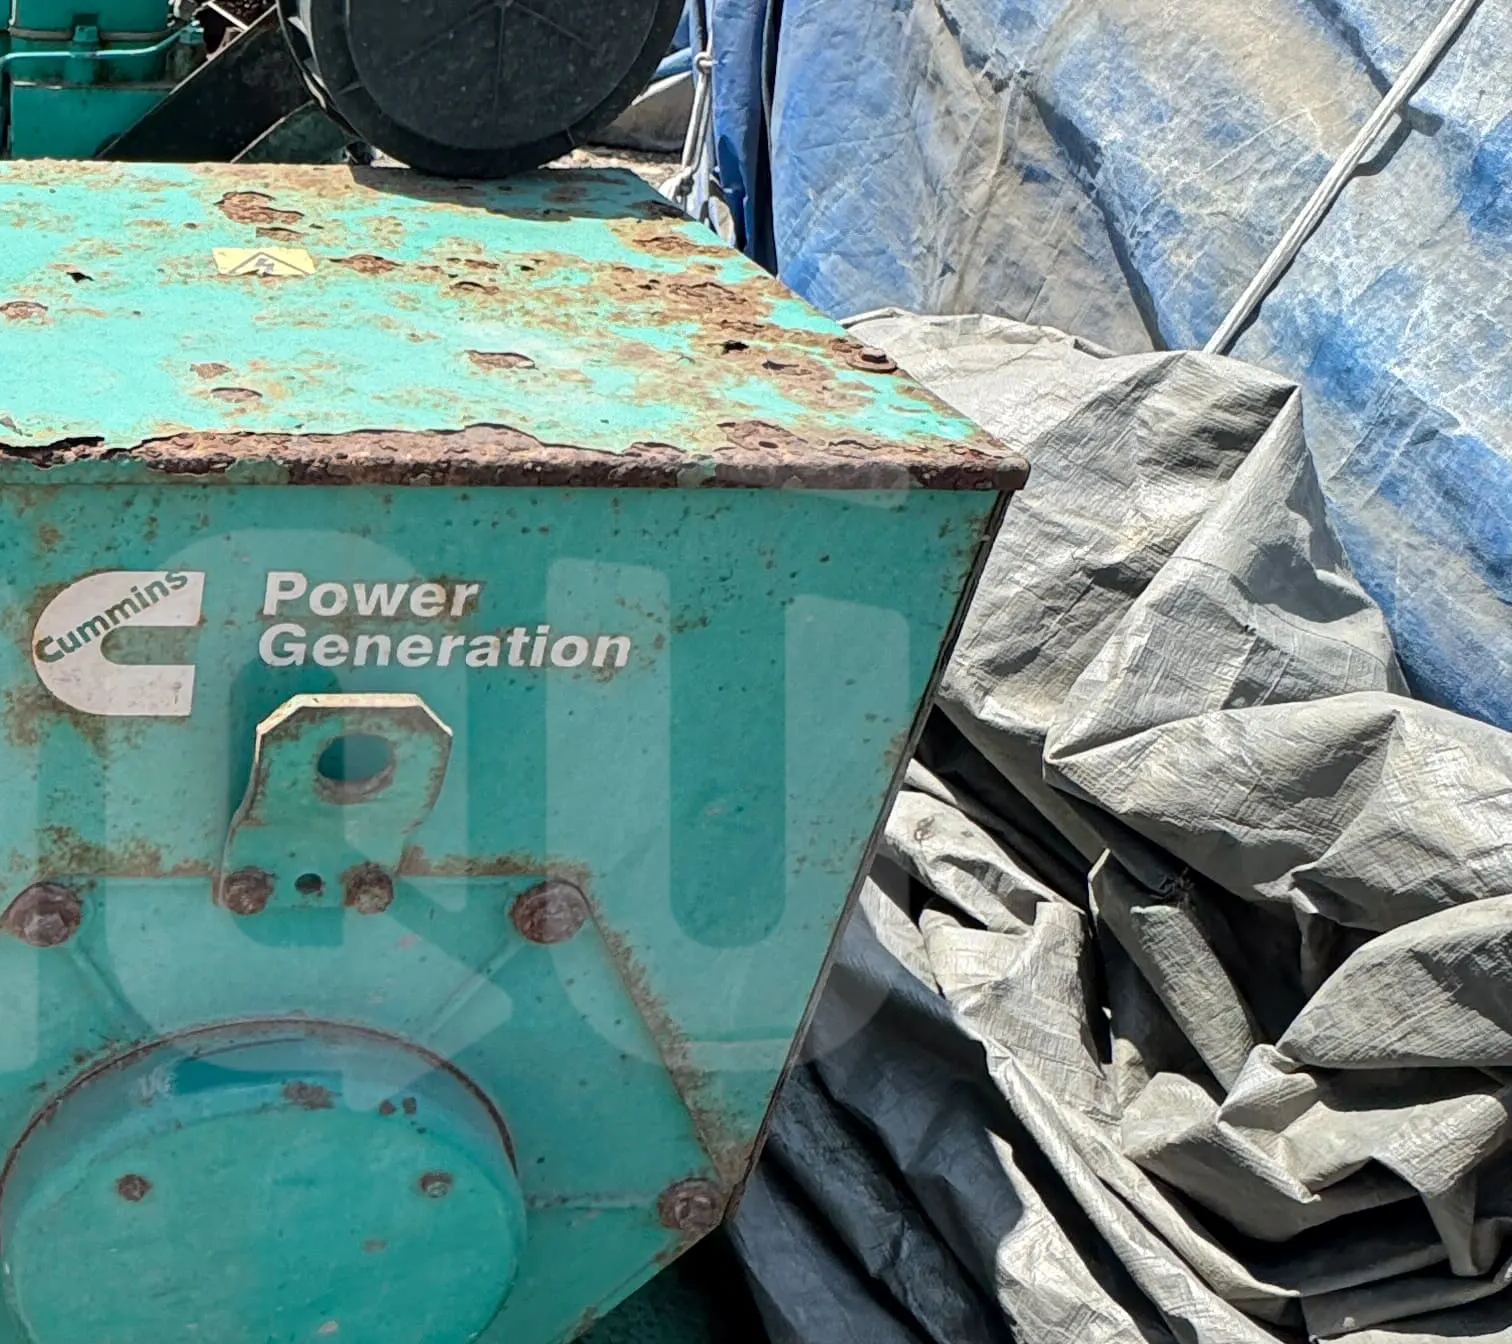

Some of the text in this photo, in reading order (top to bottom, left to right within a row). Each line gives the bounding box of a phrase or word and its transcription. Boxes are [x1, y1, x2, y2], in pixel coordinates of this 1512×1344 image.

[34, 570, 189, 664] Cummins
[262, 570, 481, 618] Power
[257, 622, 633, 669] Generation
